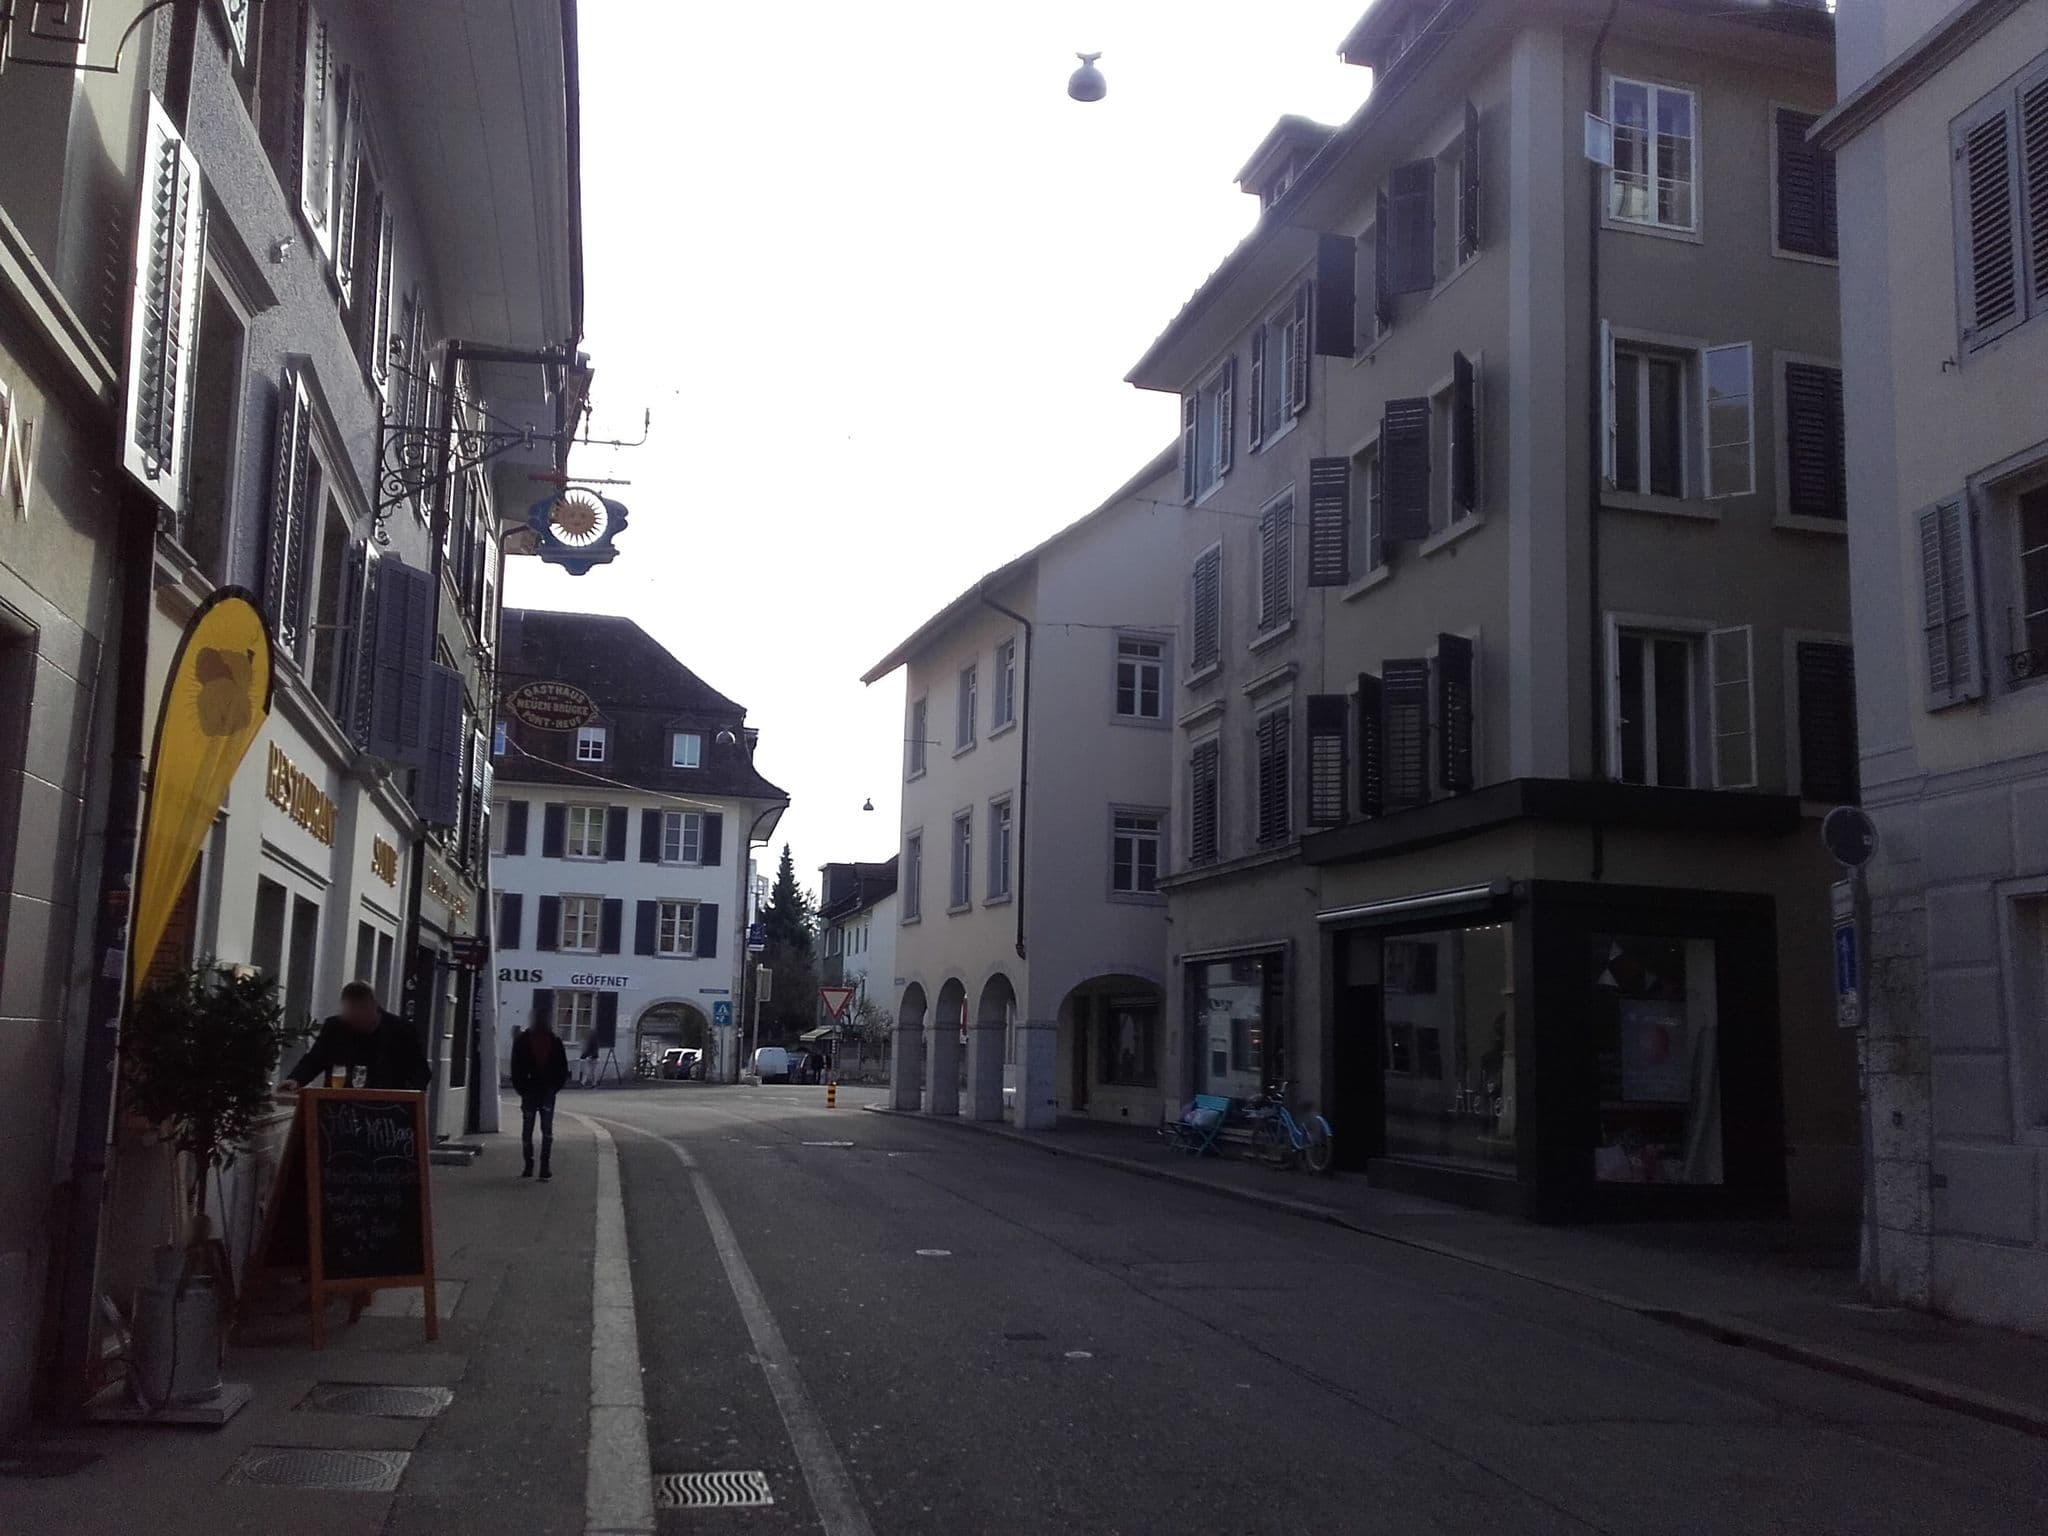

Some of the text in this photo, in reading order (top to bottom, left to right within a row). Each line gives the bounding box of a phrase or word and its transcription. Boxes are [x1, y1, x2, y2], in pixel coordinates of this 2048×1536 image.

[524, 684, 585, 704] GASTHAUS
[265, 740, 337, 848] RESTAURANT
[571, 973, 629, 987] GEÖFFNET
